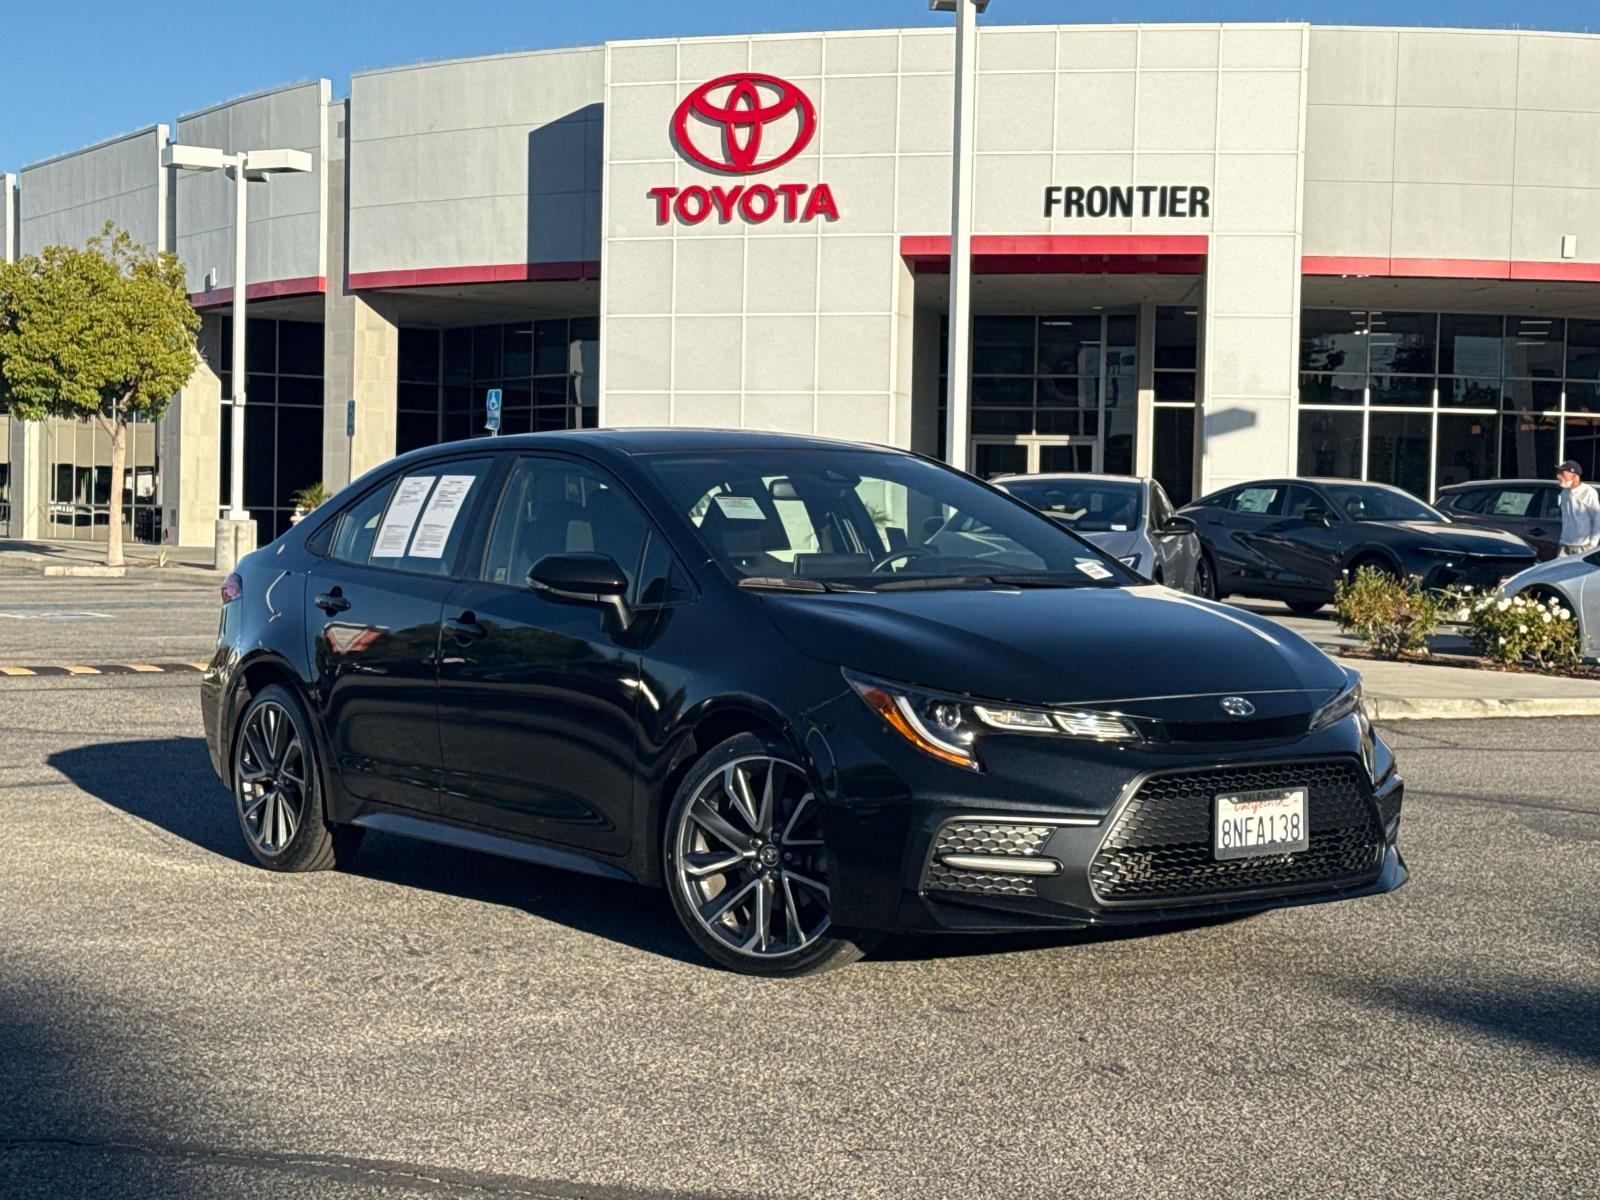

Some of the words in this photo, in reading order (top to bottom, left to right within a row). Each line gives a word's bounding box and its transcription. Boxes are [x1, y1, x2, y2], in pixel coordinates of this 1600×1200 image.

[649, 184, 840, 224] TOYOTA
[1044, 185, 1210, 218] FRONTIER
[1241, 790, 1281, 802] VALENCIA
[1222, 813, 1300, 848] 8NFA138
